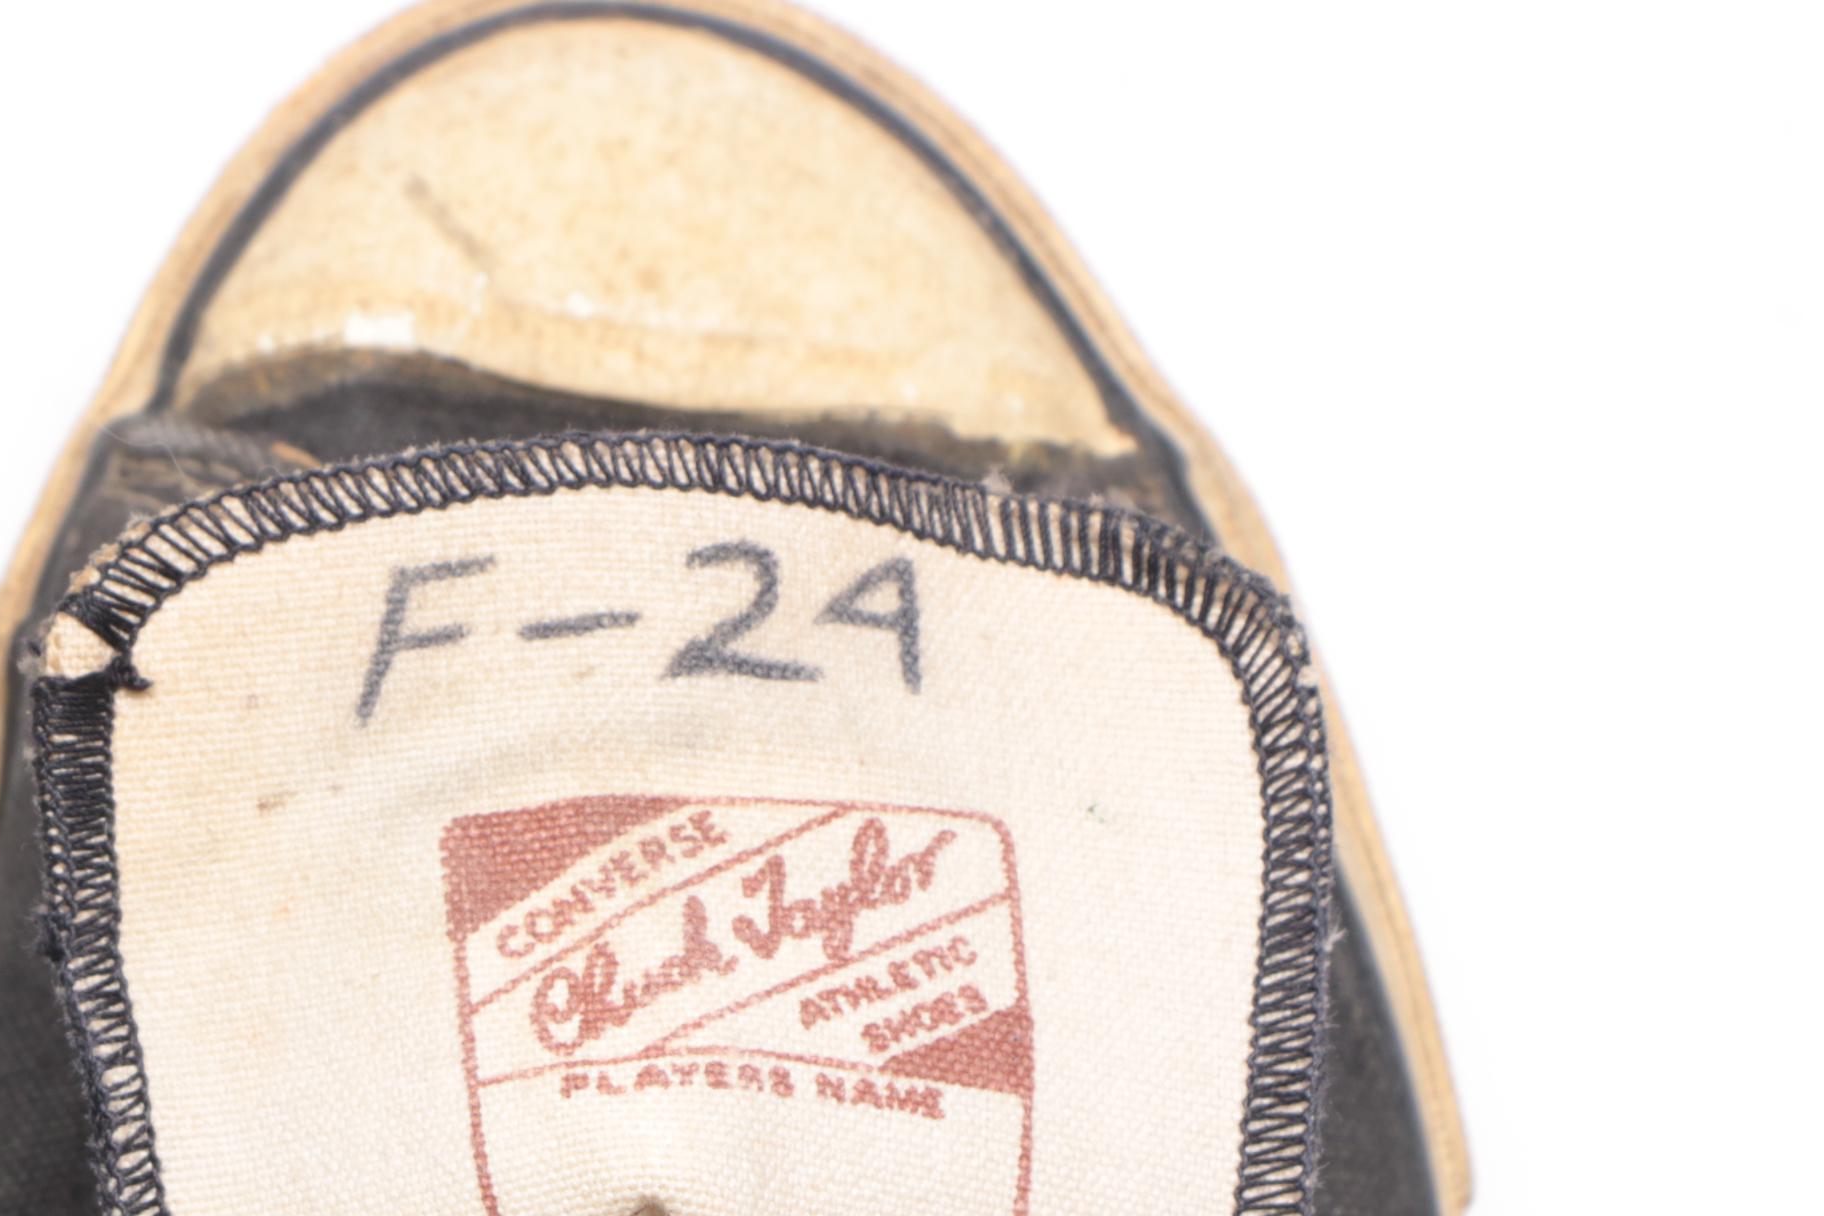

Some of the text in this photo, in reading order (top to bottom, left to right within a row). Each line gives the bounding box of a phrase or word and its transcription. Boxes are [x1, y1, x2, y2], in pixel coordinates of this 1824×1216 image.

[354, 540, 922, 727] F-24
[496, 810, 732, 958] CONVERSE
[529, 817, 956, 1056] Chuck Taylor
[800, 936, 977, 1030] ATHLETIC
[861, 984, 988, 1053] SHOES
[560, 1061, 945, 1119] PLAYERS NAME
